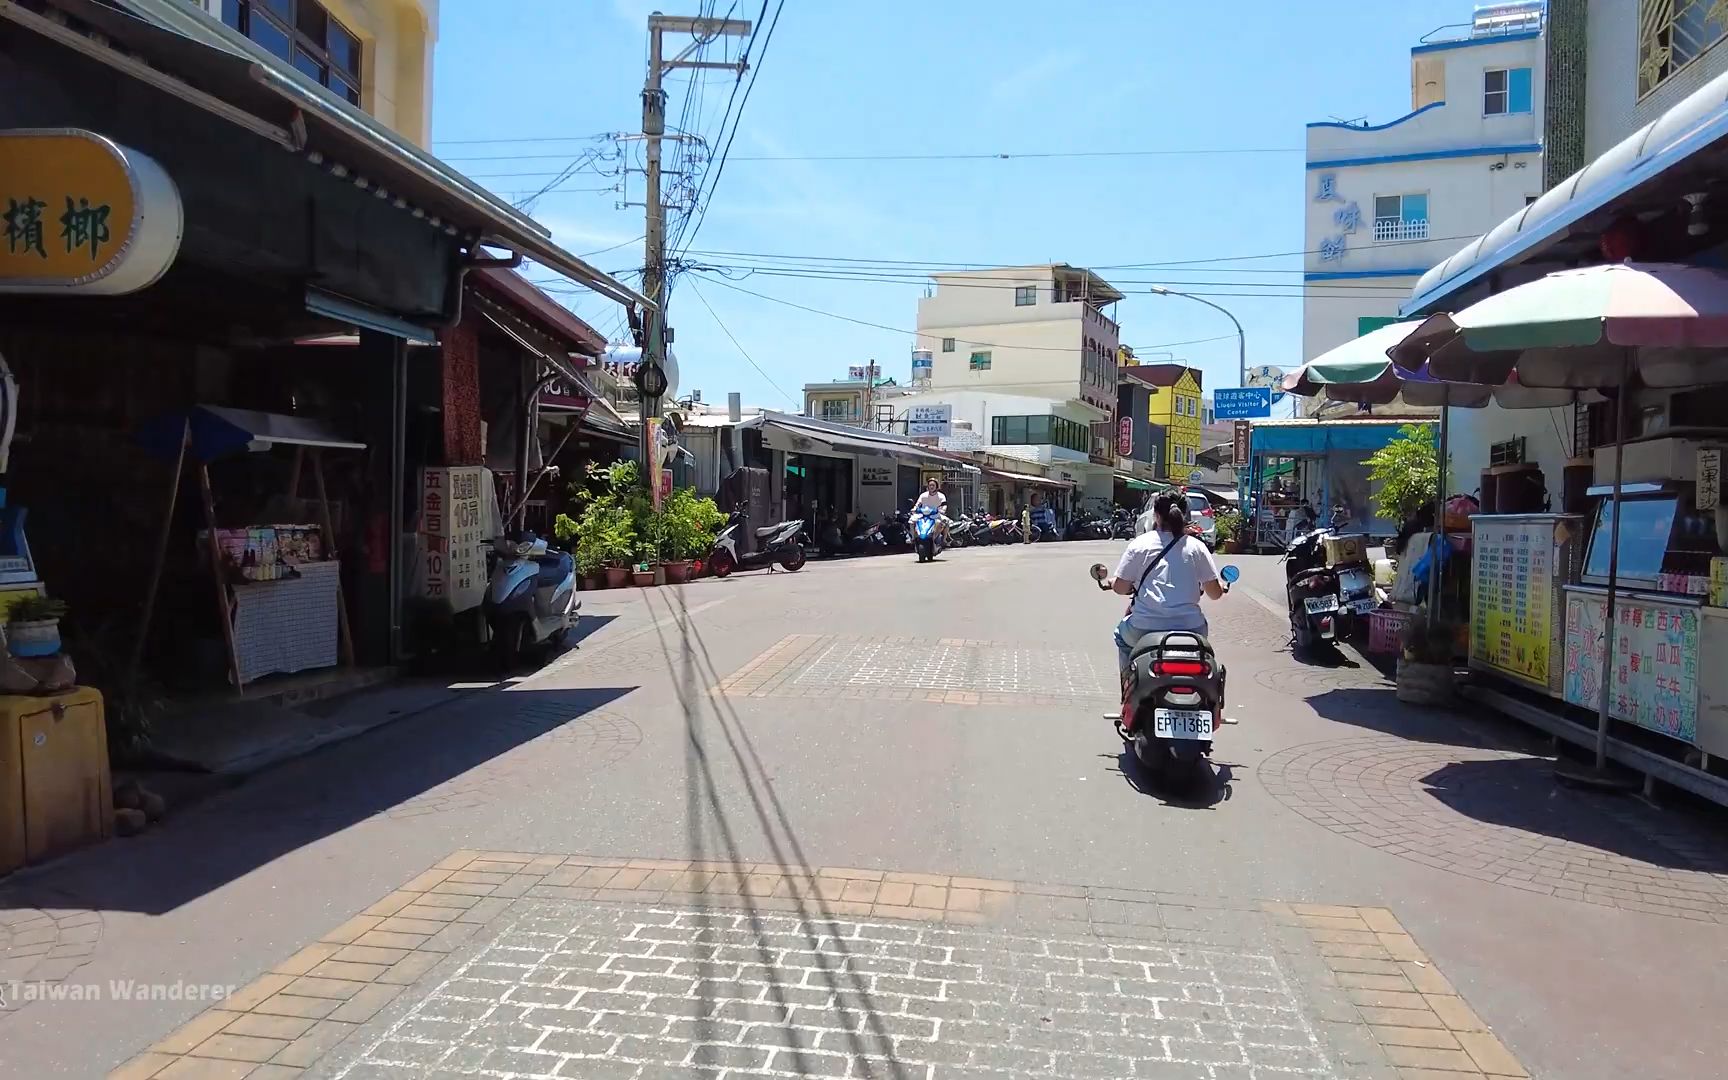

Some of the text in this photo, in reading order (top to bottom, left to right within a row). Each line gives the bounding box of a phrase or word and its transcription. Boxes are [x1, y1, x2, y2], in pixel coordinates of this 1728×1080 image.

[3, 195, 111, 262] 檳榔
[1655, 609, 1669, 729] 西瓜牛奶
[1668, 614, 1682, 734] 木瓜牛奶
